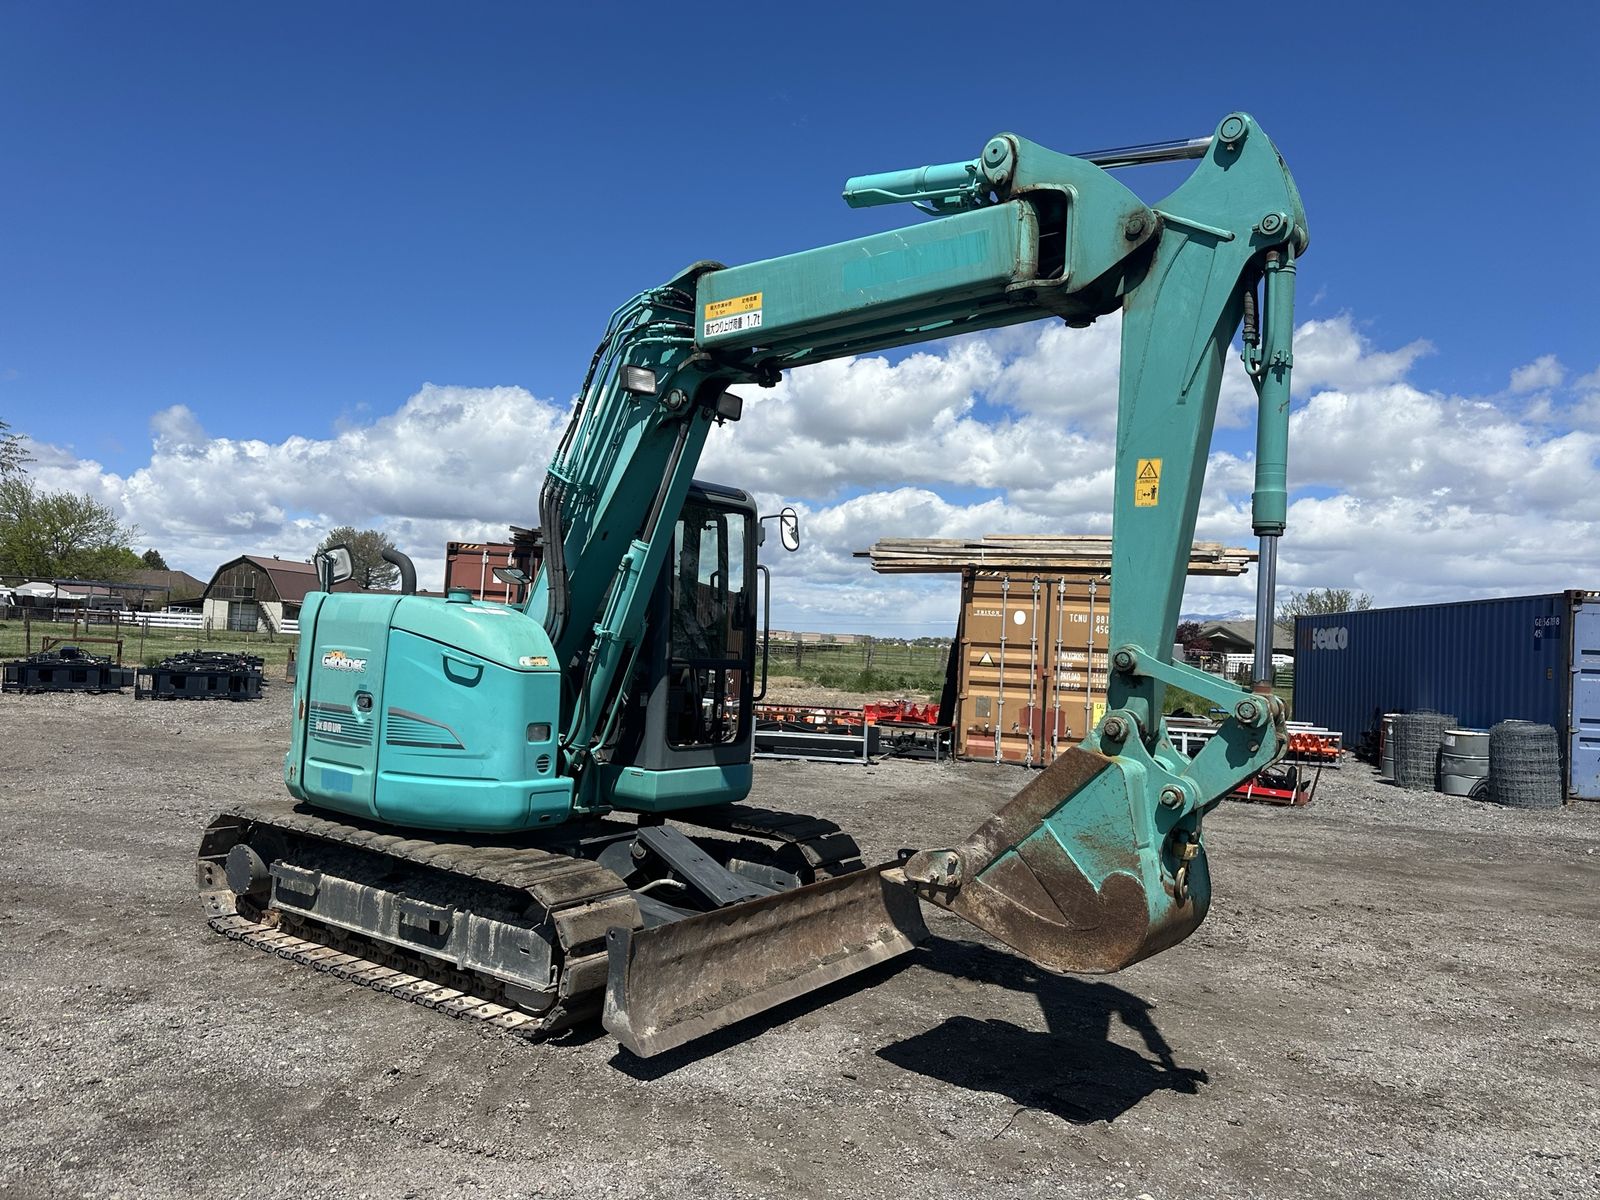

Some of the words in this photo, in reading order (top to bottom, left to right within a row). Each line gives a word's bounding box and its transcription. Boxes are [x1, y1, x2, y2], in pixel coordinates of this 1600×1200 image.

[747, 313, 760, 327] 1.7t
[1069, 613, 1088, 623] TCNU
[1312, 627, 1348, 650] seaco
